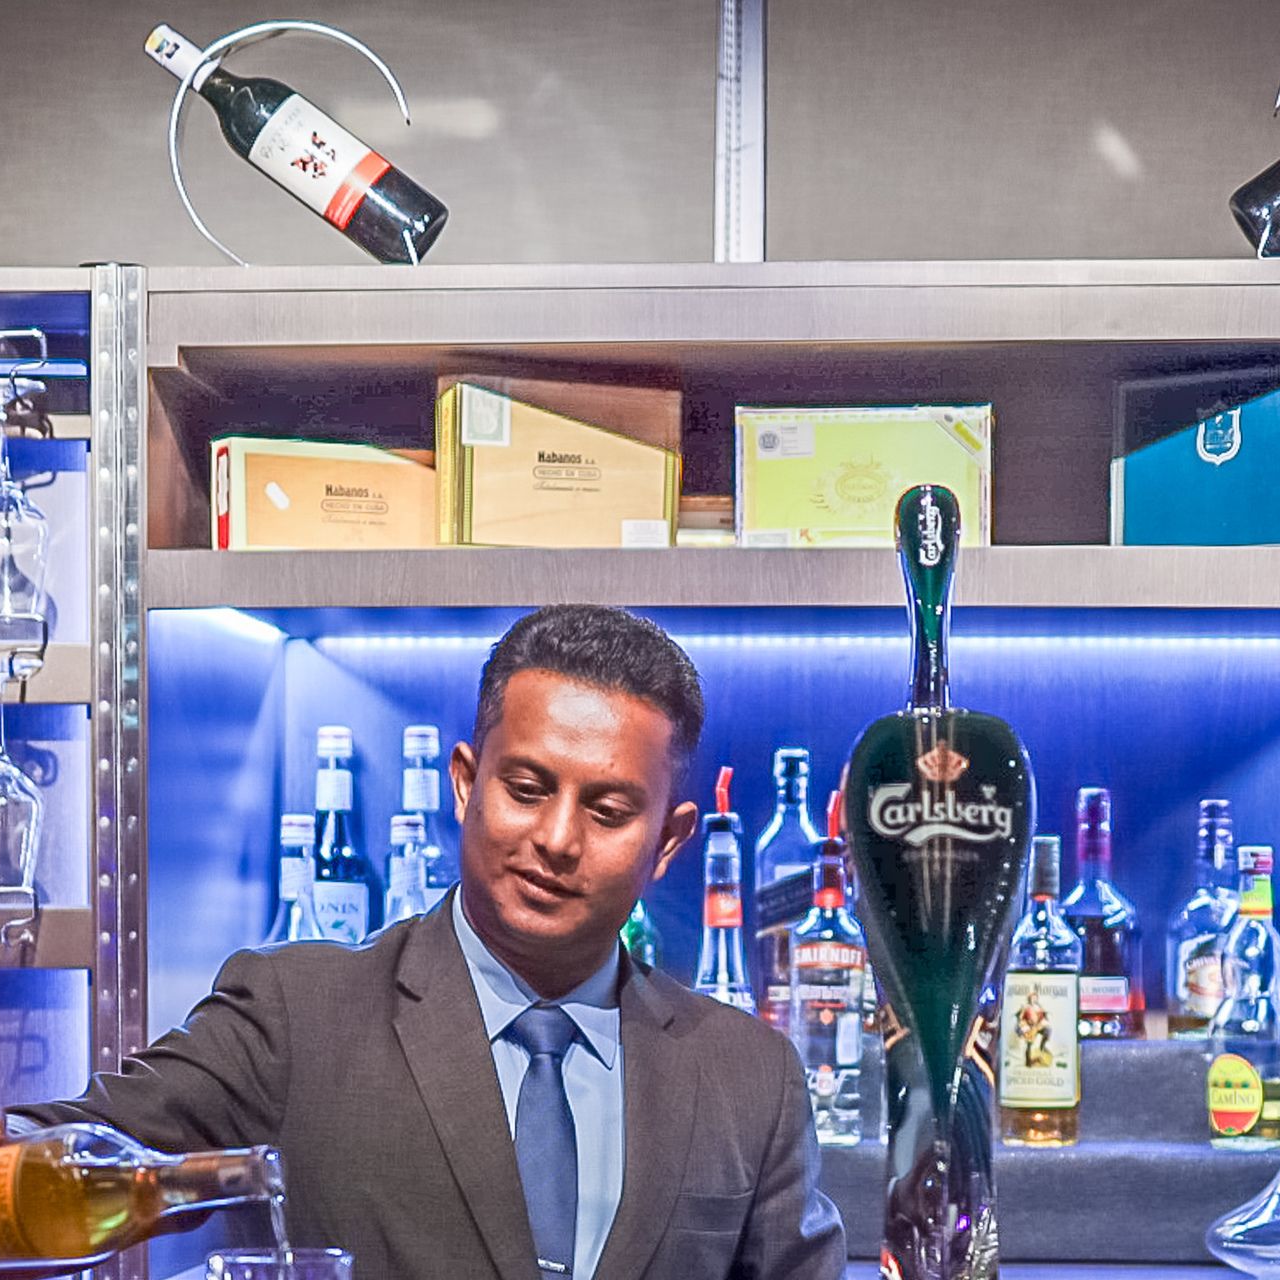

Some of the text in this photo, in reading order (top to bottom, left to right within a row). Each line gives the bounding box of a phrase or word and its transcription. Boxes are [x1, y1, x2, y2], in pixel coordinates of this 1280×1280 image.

[538, 451, 581, 464] Habanos
[325, 484, 368, 497] Habanos
[870, 782, 1013, 847] Carlsberg
[793, 947, 862, 967] SMIRNOFF
